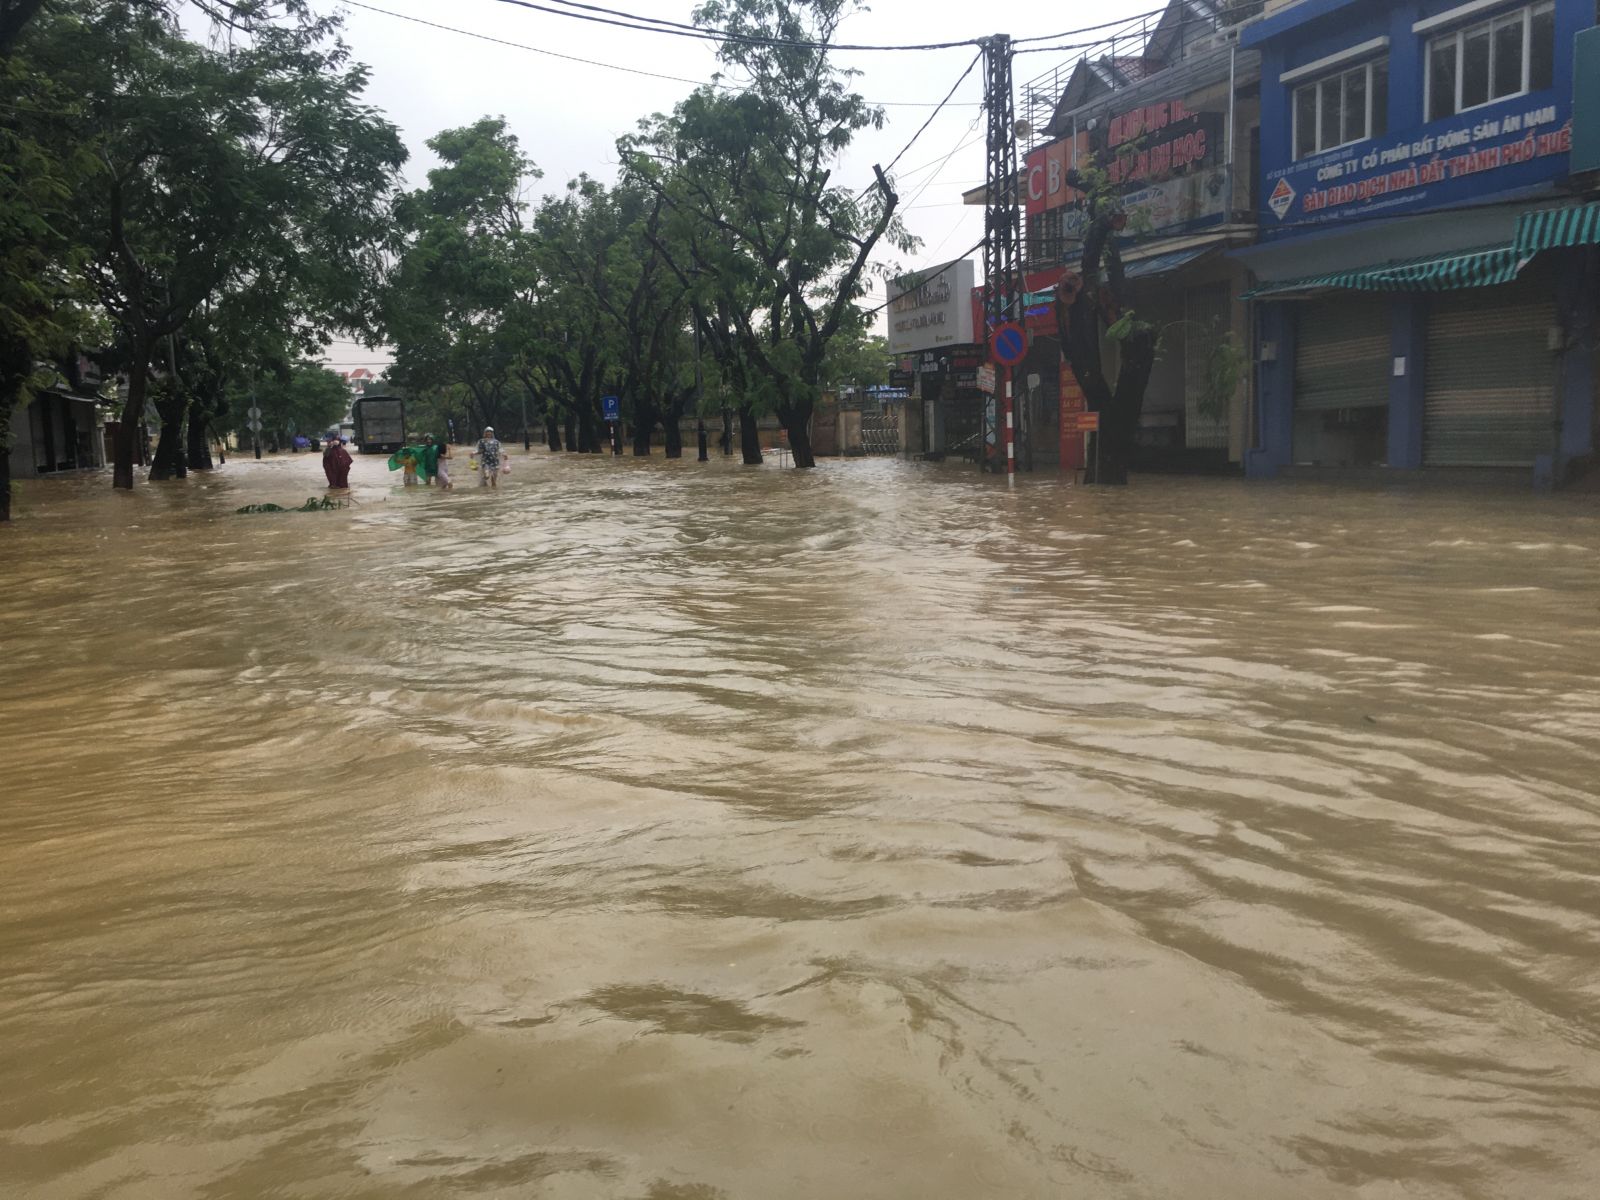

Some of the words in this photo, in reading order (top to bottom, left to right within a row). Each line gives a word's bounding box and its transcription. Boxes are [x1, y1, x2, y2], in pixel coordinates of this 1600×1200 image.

[1172, 129, 1206, 169] HỌC
[1317, 164, 1343, 182] CÔNG
[1345, 159, 1358, 174] TY
[1362, 147, 1378, 169] CỔ
[1380, 142, 1410, 165] PHẦN
[1412, 135, 1435, 157] BẤT
[1437, 129, 1470, 151] ĐỘNG
[1523, 105, 1555, 128] NAM
[1328, 182, 1357, 206] GIAO
[1357, 174, 1389, 202] DỊCH
[1390, 162, 1418, 192] NHÀ
[1420, 152, 1447, 185] ĐẤT
[1448, 146, 1500, 178] THÀNH
[1501, 128, 1535, 166] PHỐ
[1536, 118, 1572, 158] HUẾ
[608, 399, 615, 409] P
